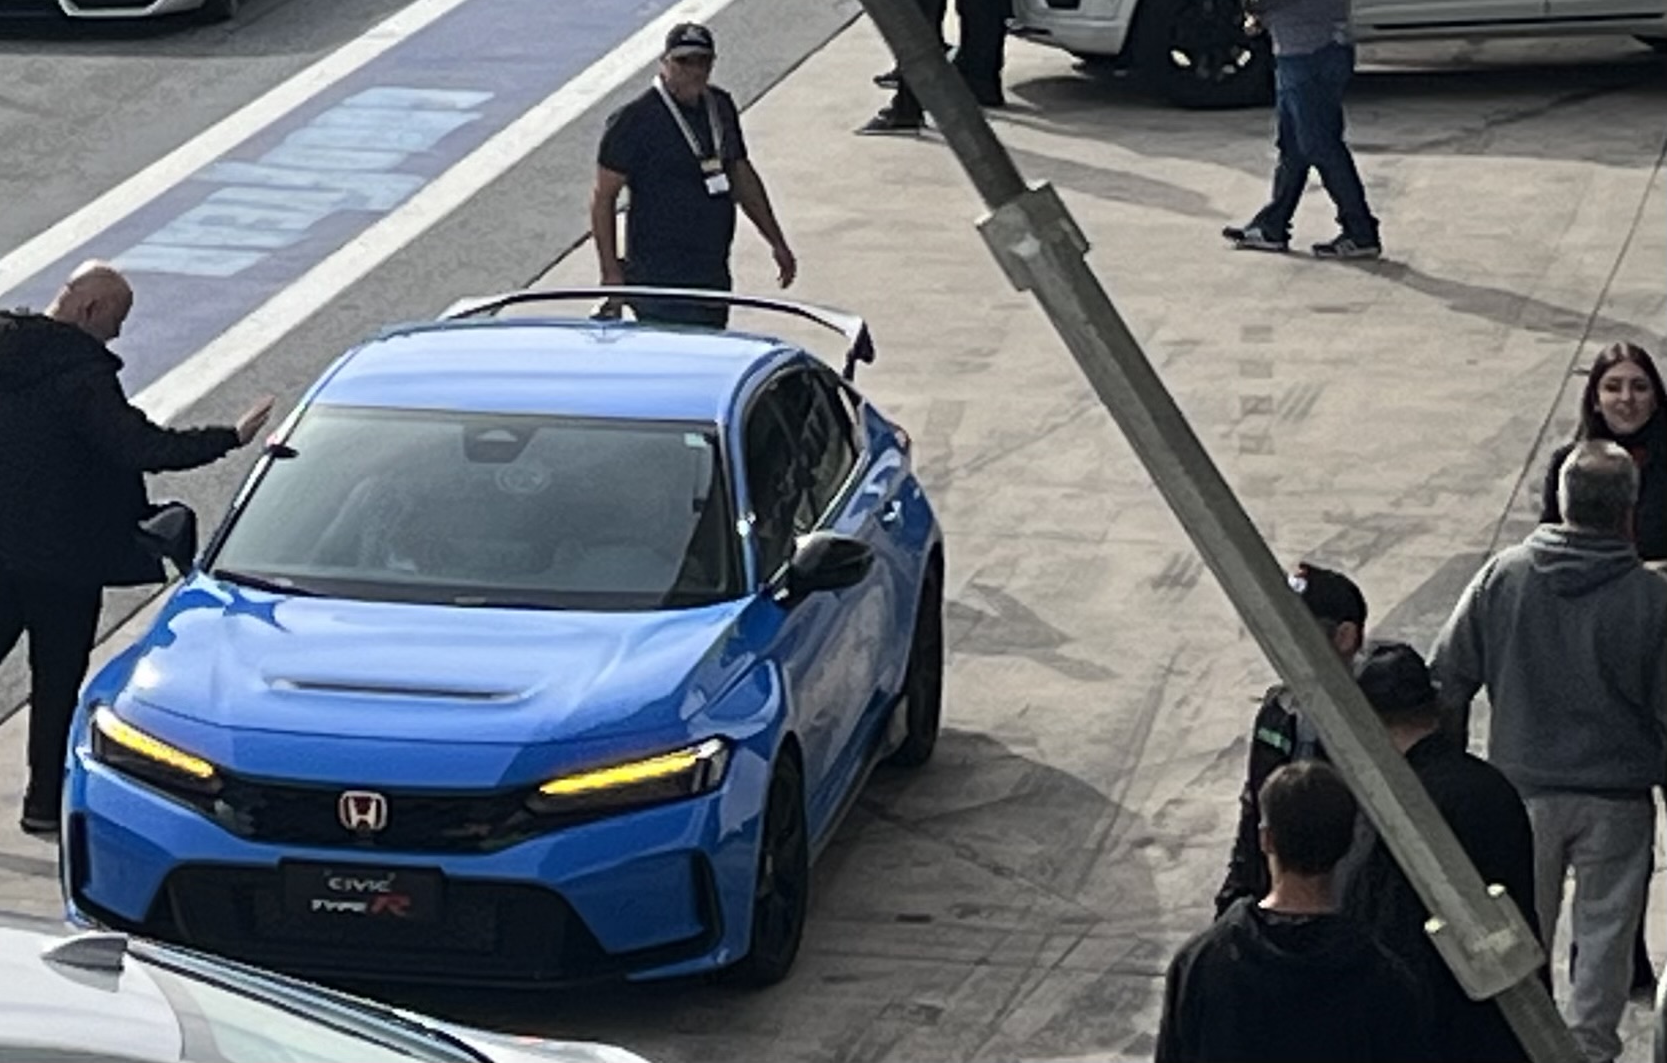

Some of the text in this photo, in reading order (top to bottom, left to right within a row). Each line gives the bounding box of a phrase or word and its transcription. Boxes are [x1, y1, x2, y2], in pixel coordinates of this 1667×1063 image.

[327, 874, 395, 893] CIVIC
[311, 893, 412, 917] TYPE R
